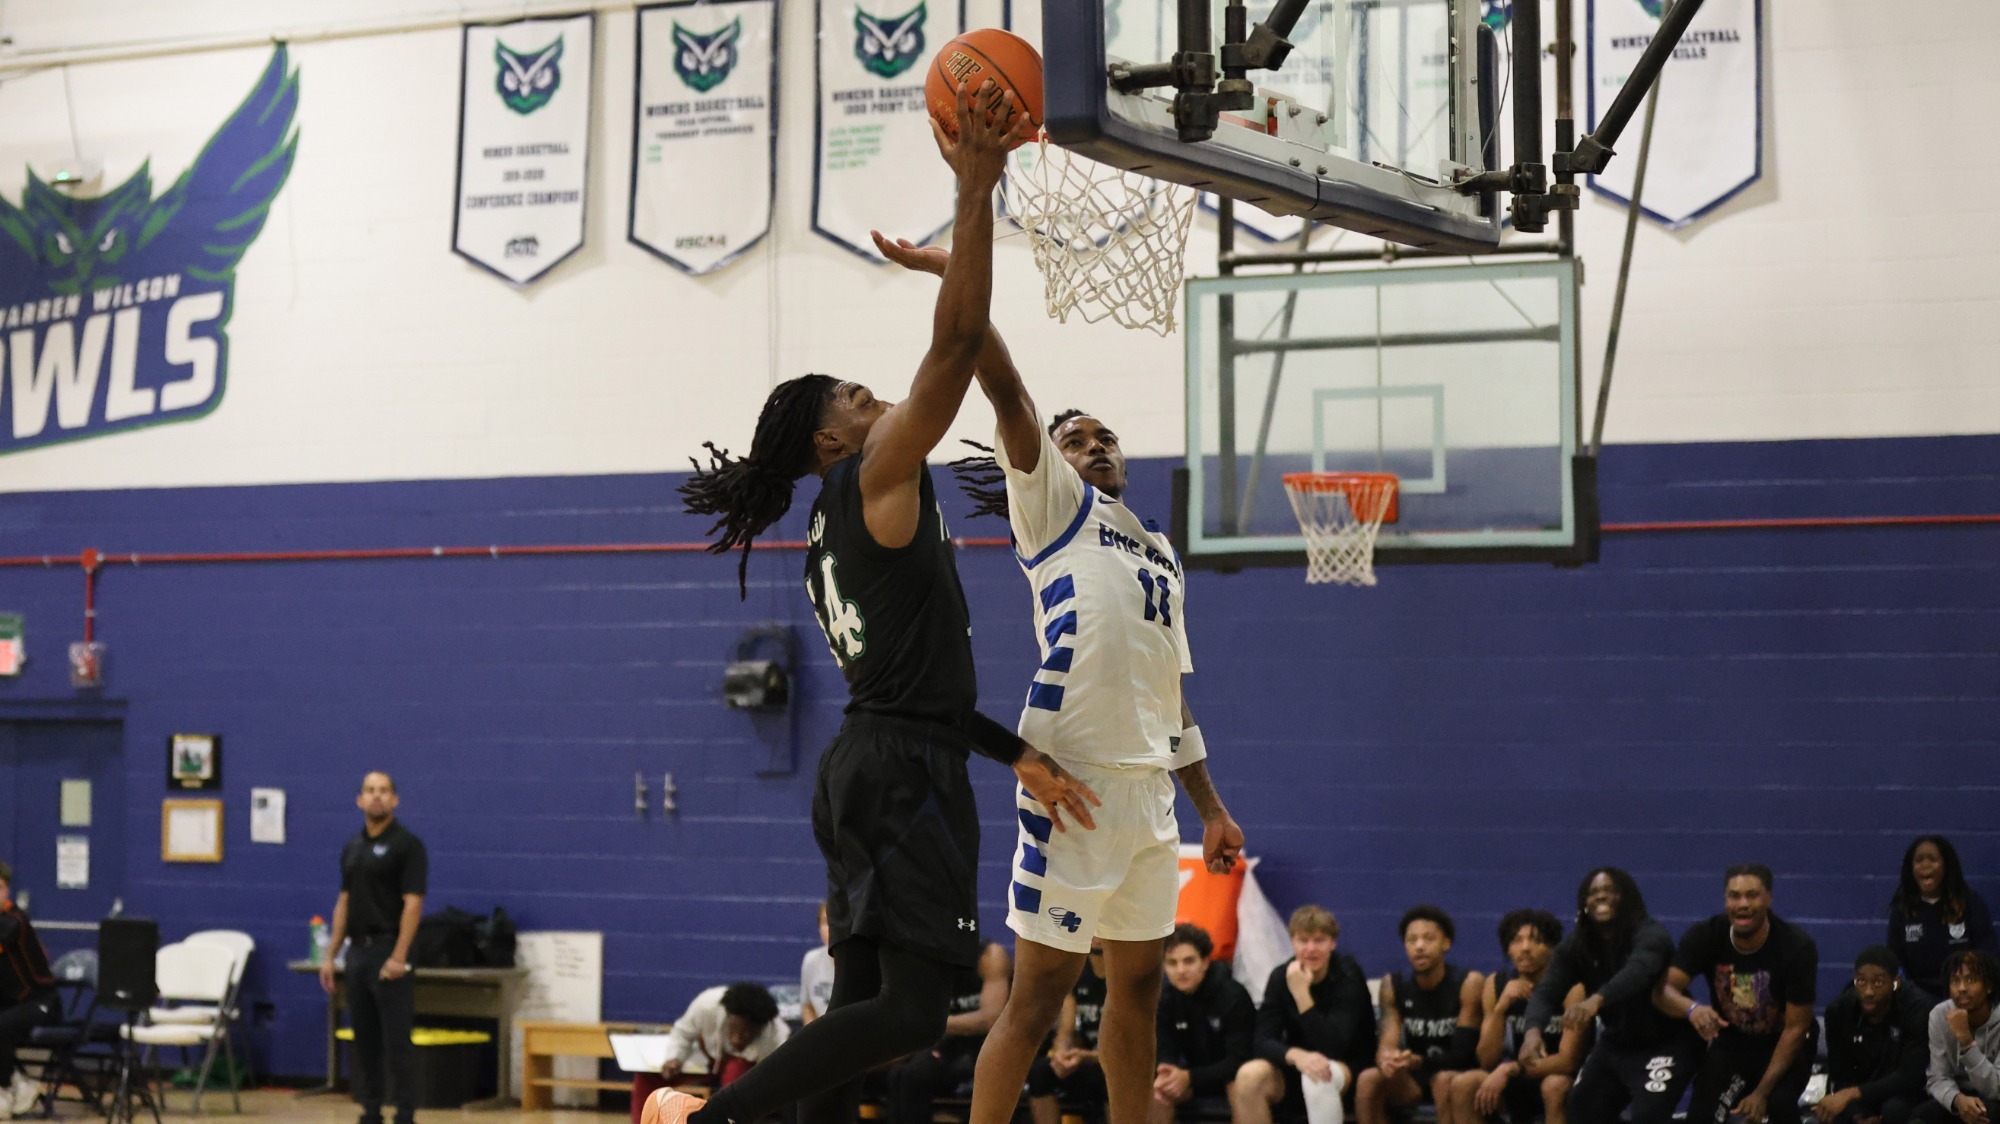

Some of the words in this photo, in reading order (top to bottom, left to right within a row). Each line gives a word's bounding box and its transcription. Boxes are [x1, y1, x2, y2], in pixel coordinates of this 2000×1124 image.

[1610, 34, 1653, 50] WOMEN
[1673, 47, 1708, 60] KILLS
[945, 50, 984, 84] THE
[693, 96, 764, 113] BASKETBALL
[871, 101, 904, 113] POINT
[465, 193, 523, 209] CONFERENCE
[526, 190, 579, 206] CHAMPIONS
[93, 274, 182, 312] WILSON
[0, 291, 224, 439] WLS
[1137, 567, 1172, 629] 11
